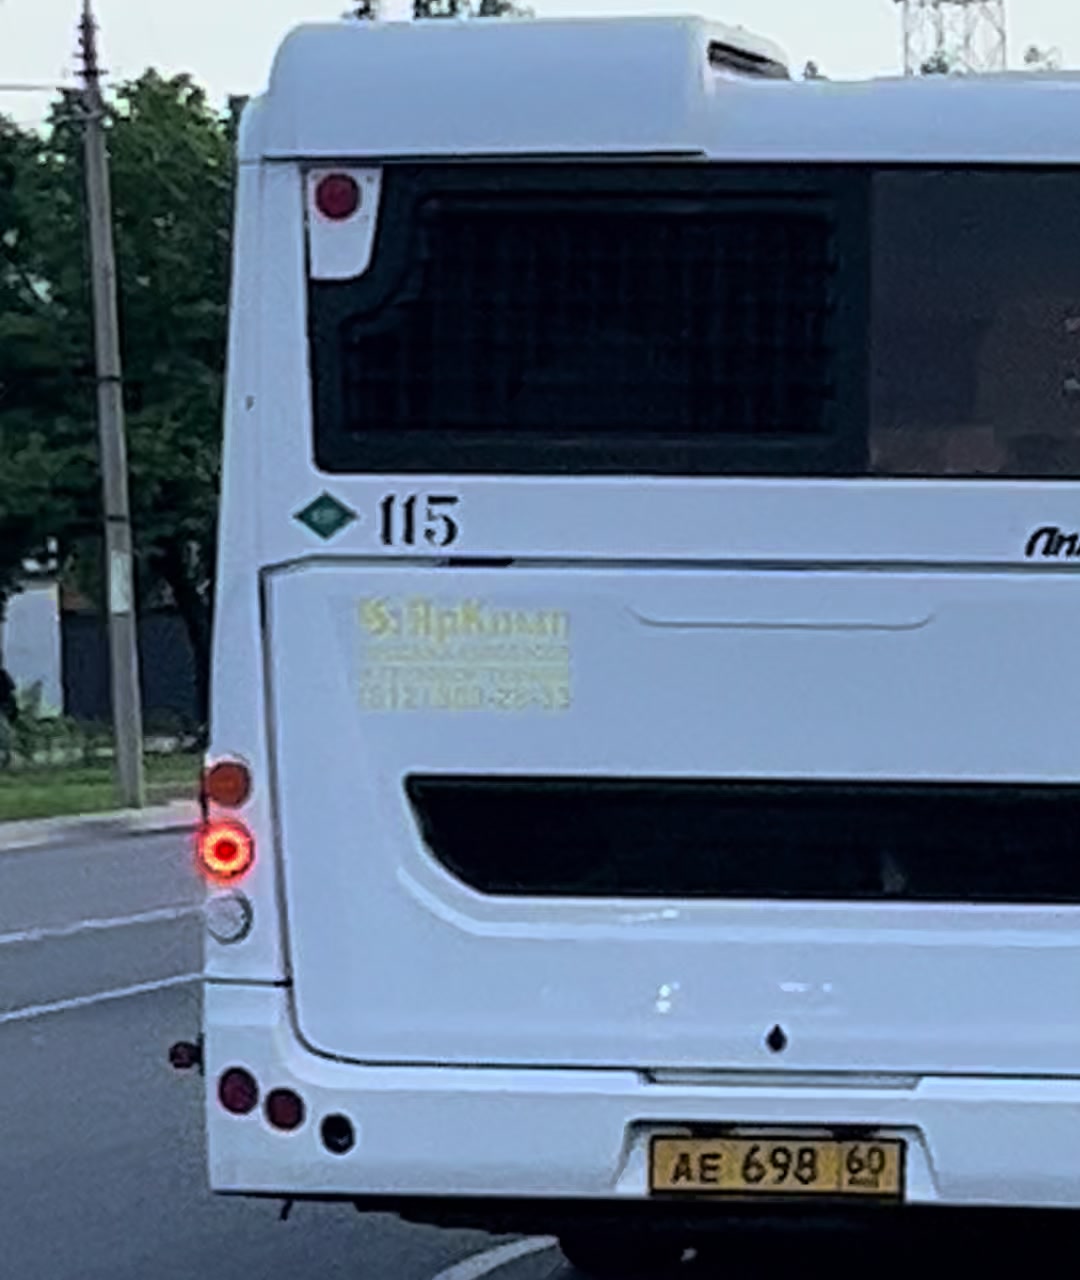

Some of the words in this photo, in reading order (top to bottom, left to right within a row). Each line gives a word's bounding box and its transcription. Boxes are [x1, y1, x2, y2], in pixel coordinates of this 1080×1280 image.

[381, 494, 459, 547] 115
[741, 1144, 818, 1185] 698
[846, 1145, 886, 1175] 60
